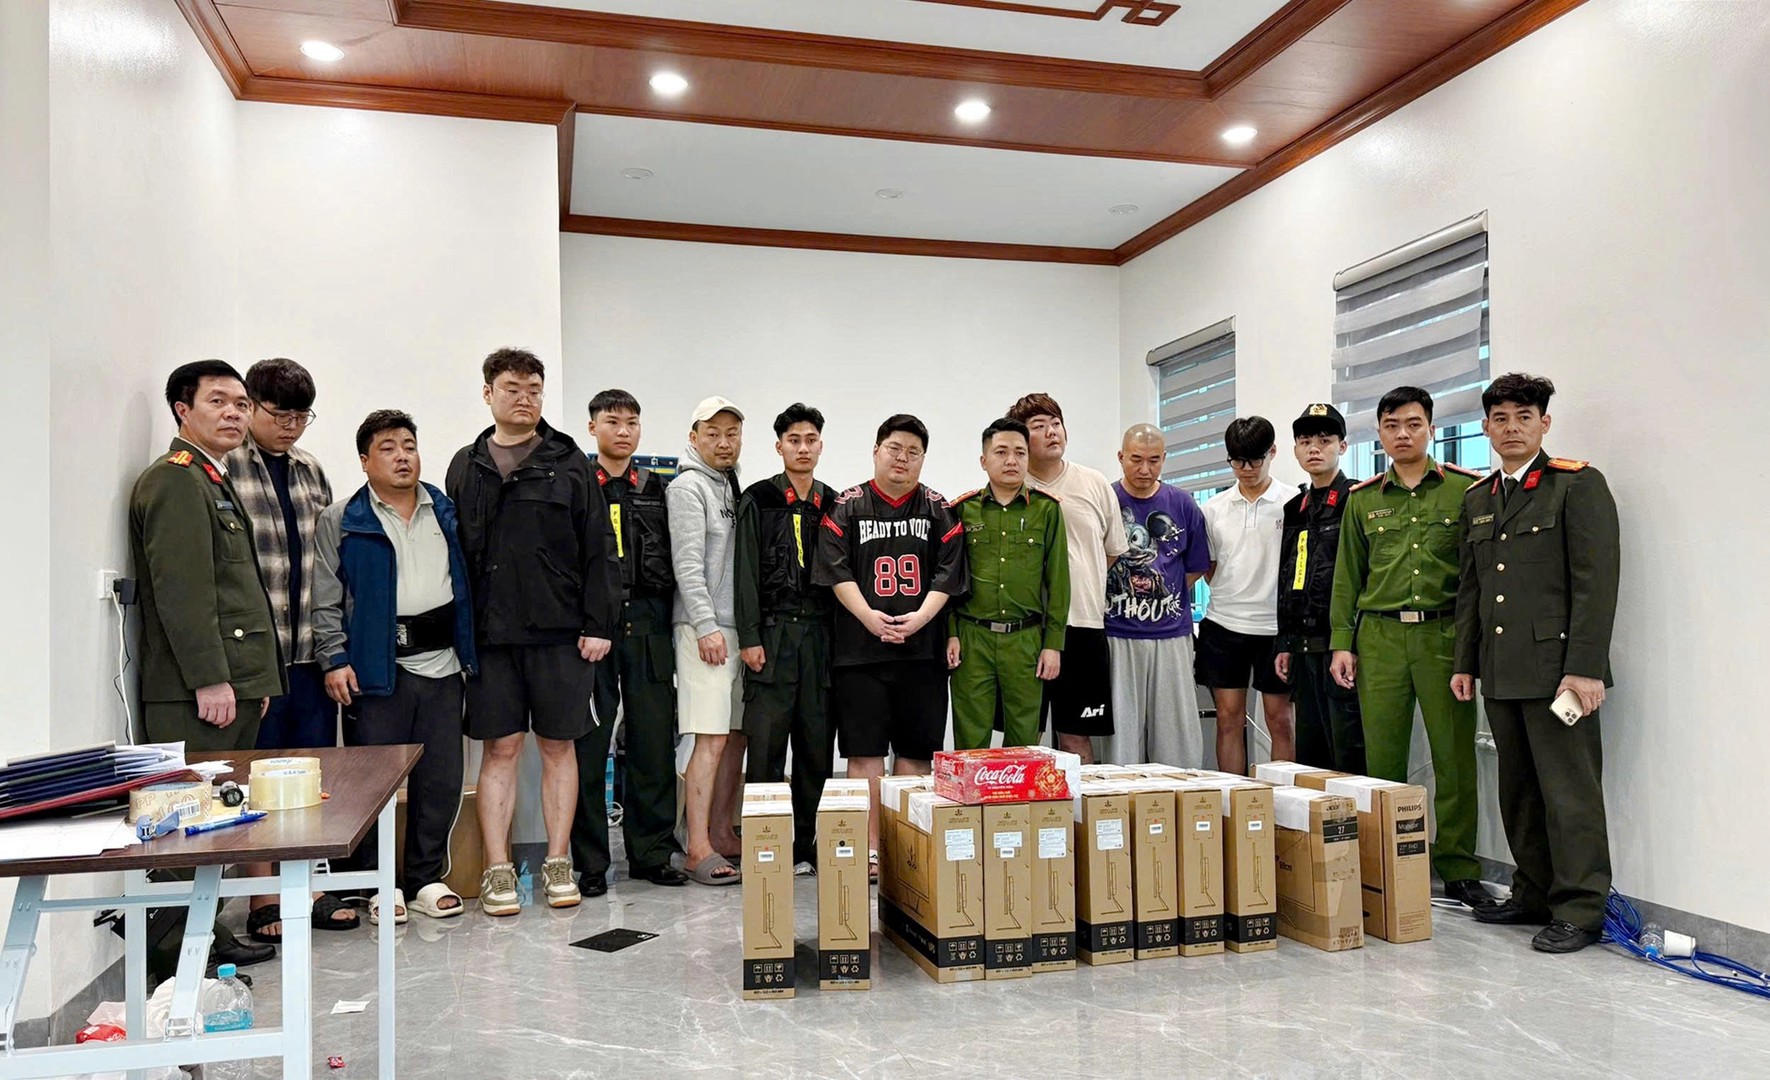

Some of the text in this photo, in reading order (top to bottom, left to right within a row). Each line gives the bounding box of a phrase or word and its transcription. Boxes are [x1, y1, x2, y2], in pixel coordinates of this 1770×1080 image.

[859, 519, 891, 544] READY
[893, 520, 907, 537] TO
[874, 554, 921, 597] 89
[1080, 704, 1105, 718] Ari
[974, 764, 1027, 785] Coca-Cola
[1397, 804, 1422, 812] PHILIPS
[1337, 825, 1346, 835] 27
